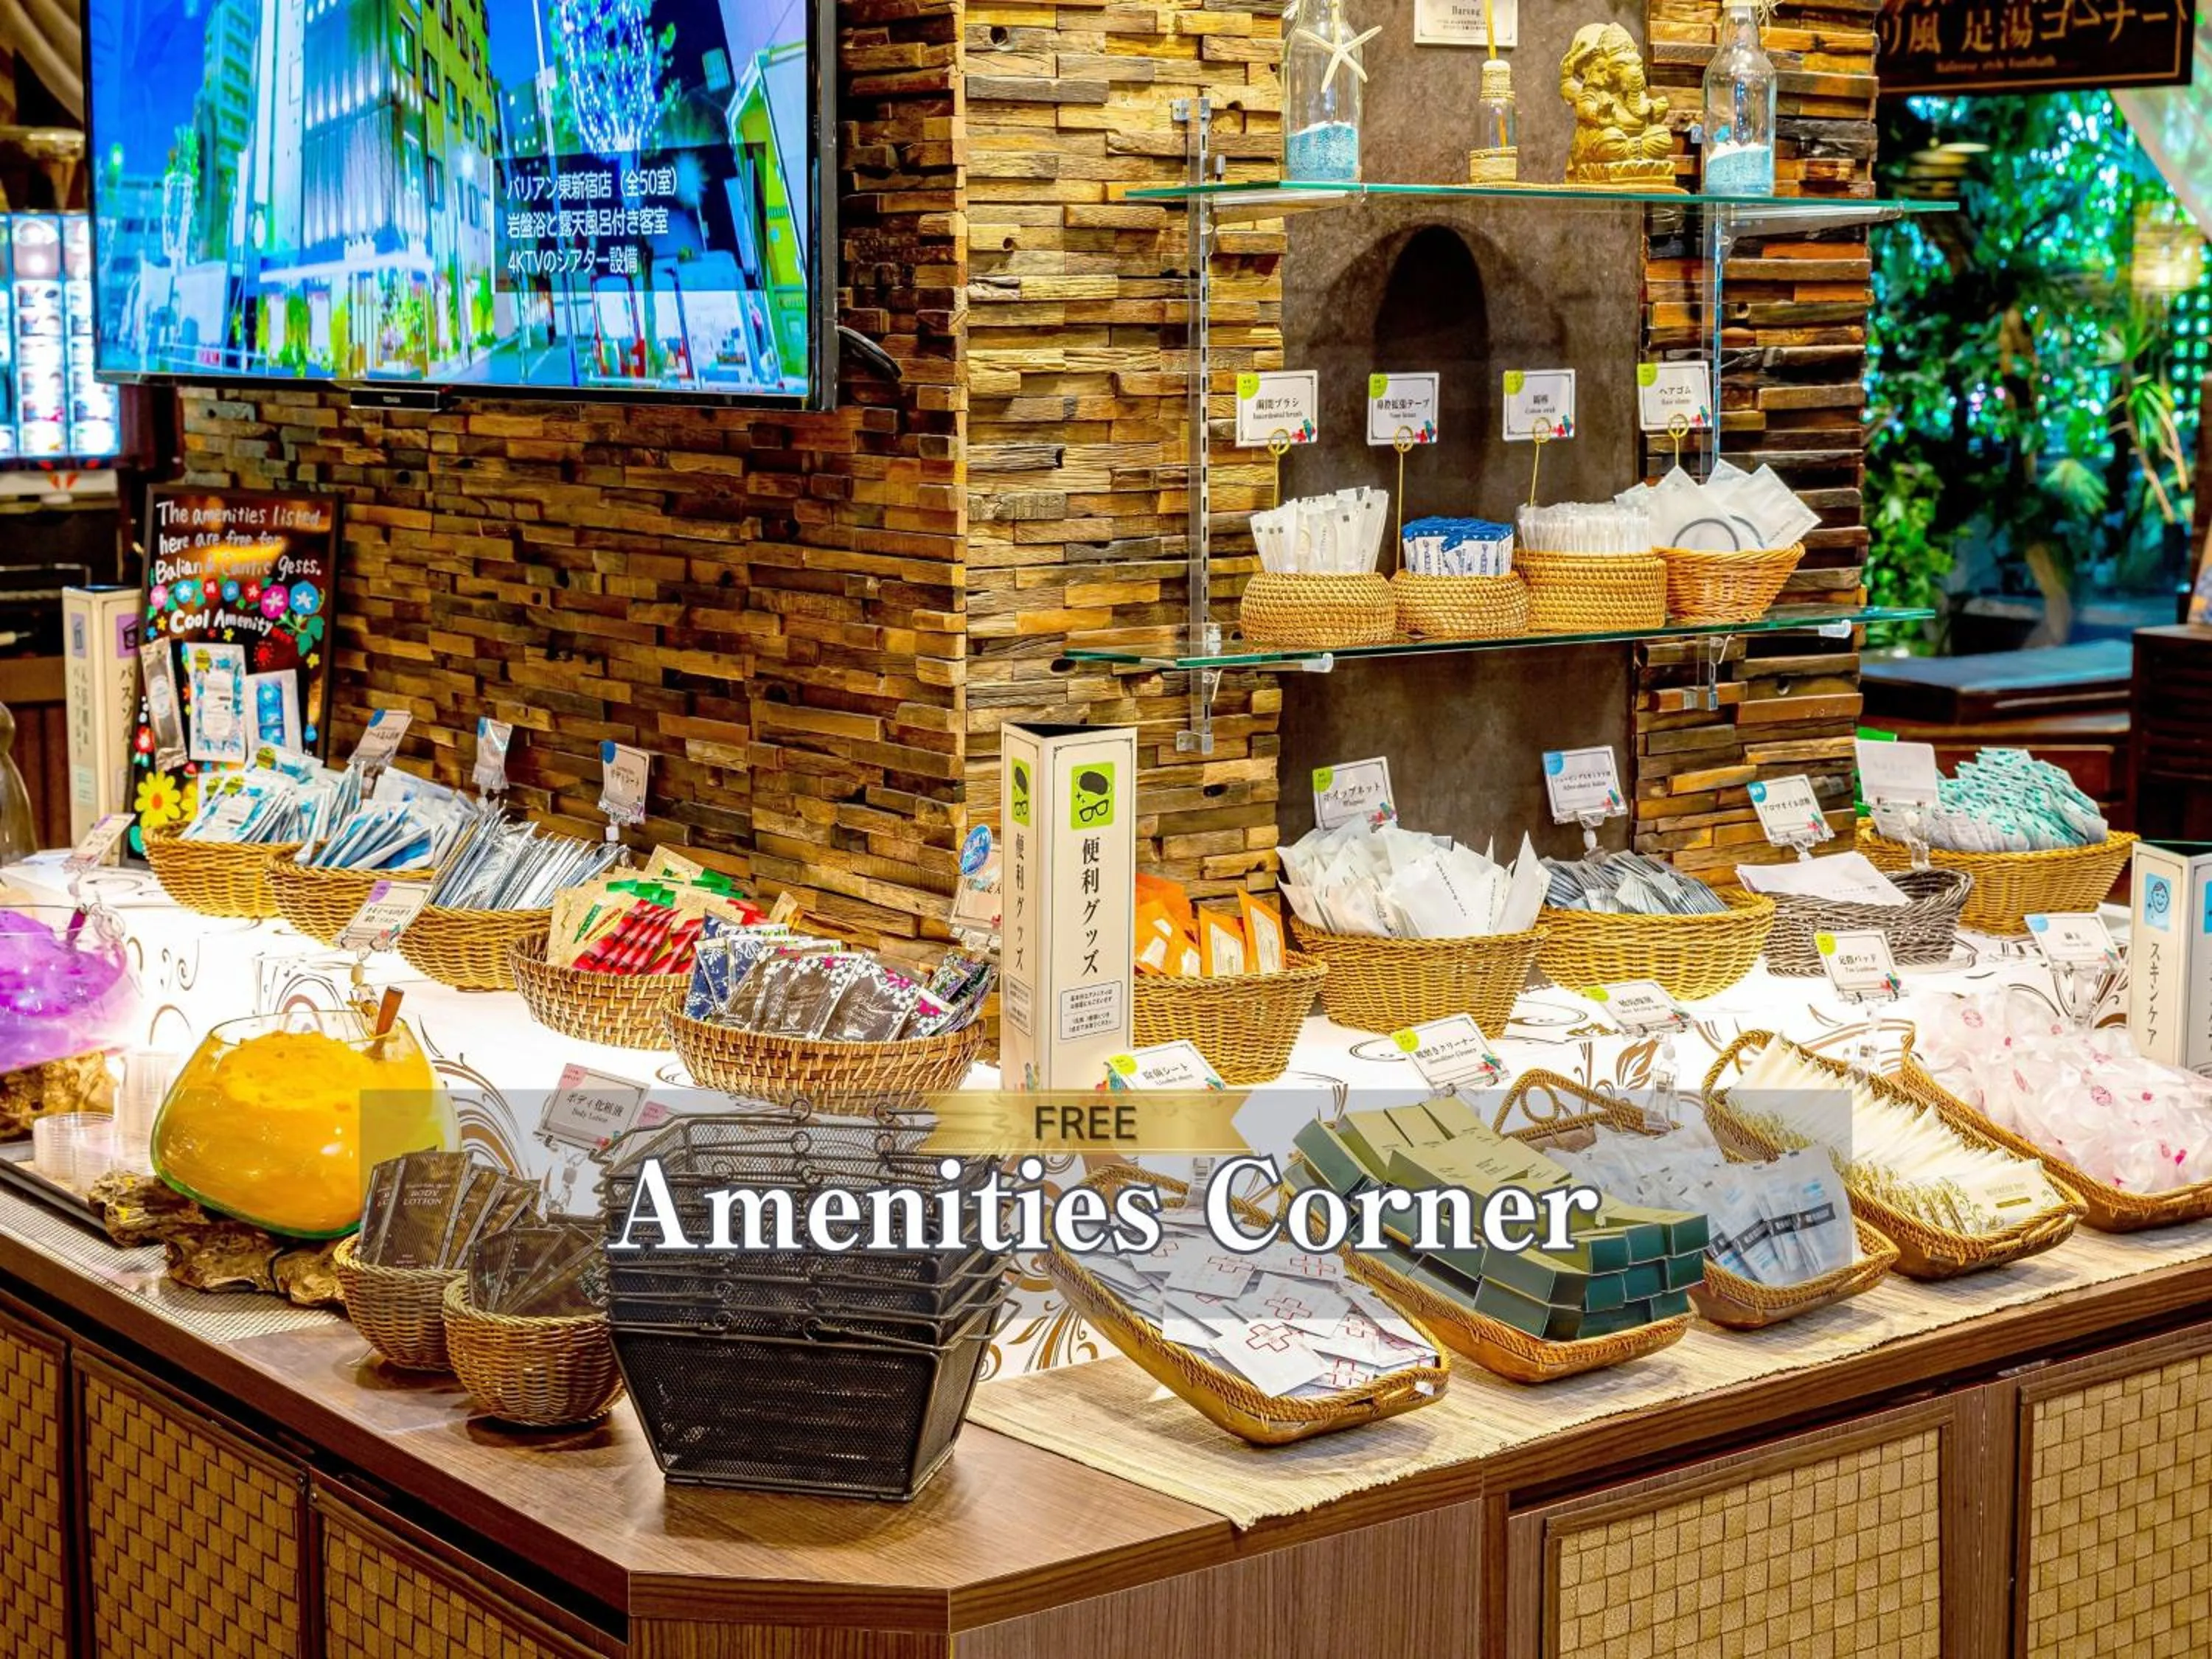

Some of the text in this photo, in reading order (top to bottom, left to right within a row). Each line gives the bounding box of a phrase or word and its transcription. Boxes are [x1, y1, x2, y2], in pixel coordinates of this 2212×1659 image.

[507, 206, 669, 239] 岩盤浴と露天風呂付き客室
[508, 246, 638, 275] 4KTVのシアター設備
[1659, 386, 1691, 395] ヘアゴム
[156, 501, 321, 526] The amenities listed
[159, 533, 189, 555] here
[195, 532, 220, 548] are
[226, 529, 253, 547] free
[156, 558, 202, 584] Balian
[278, 555, 322, 582] gests.
[170, 608, 274, 636] Cool Amenity
[1015, 833, 1025, 972] 便利グッズ
[1082, 838, 1100, 978] 便利グッズ
[2146, 943, 2160, 1046] スキンケア
